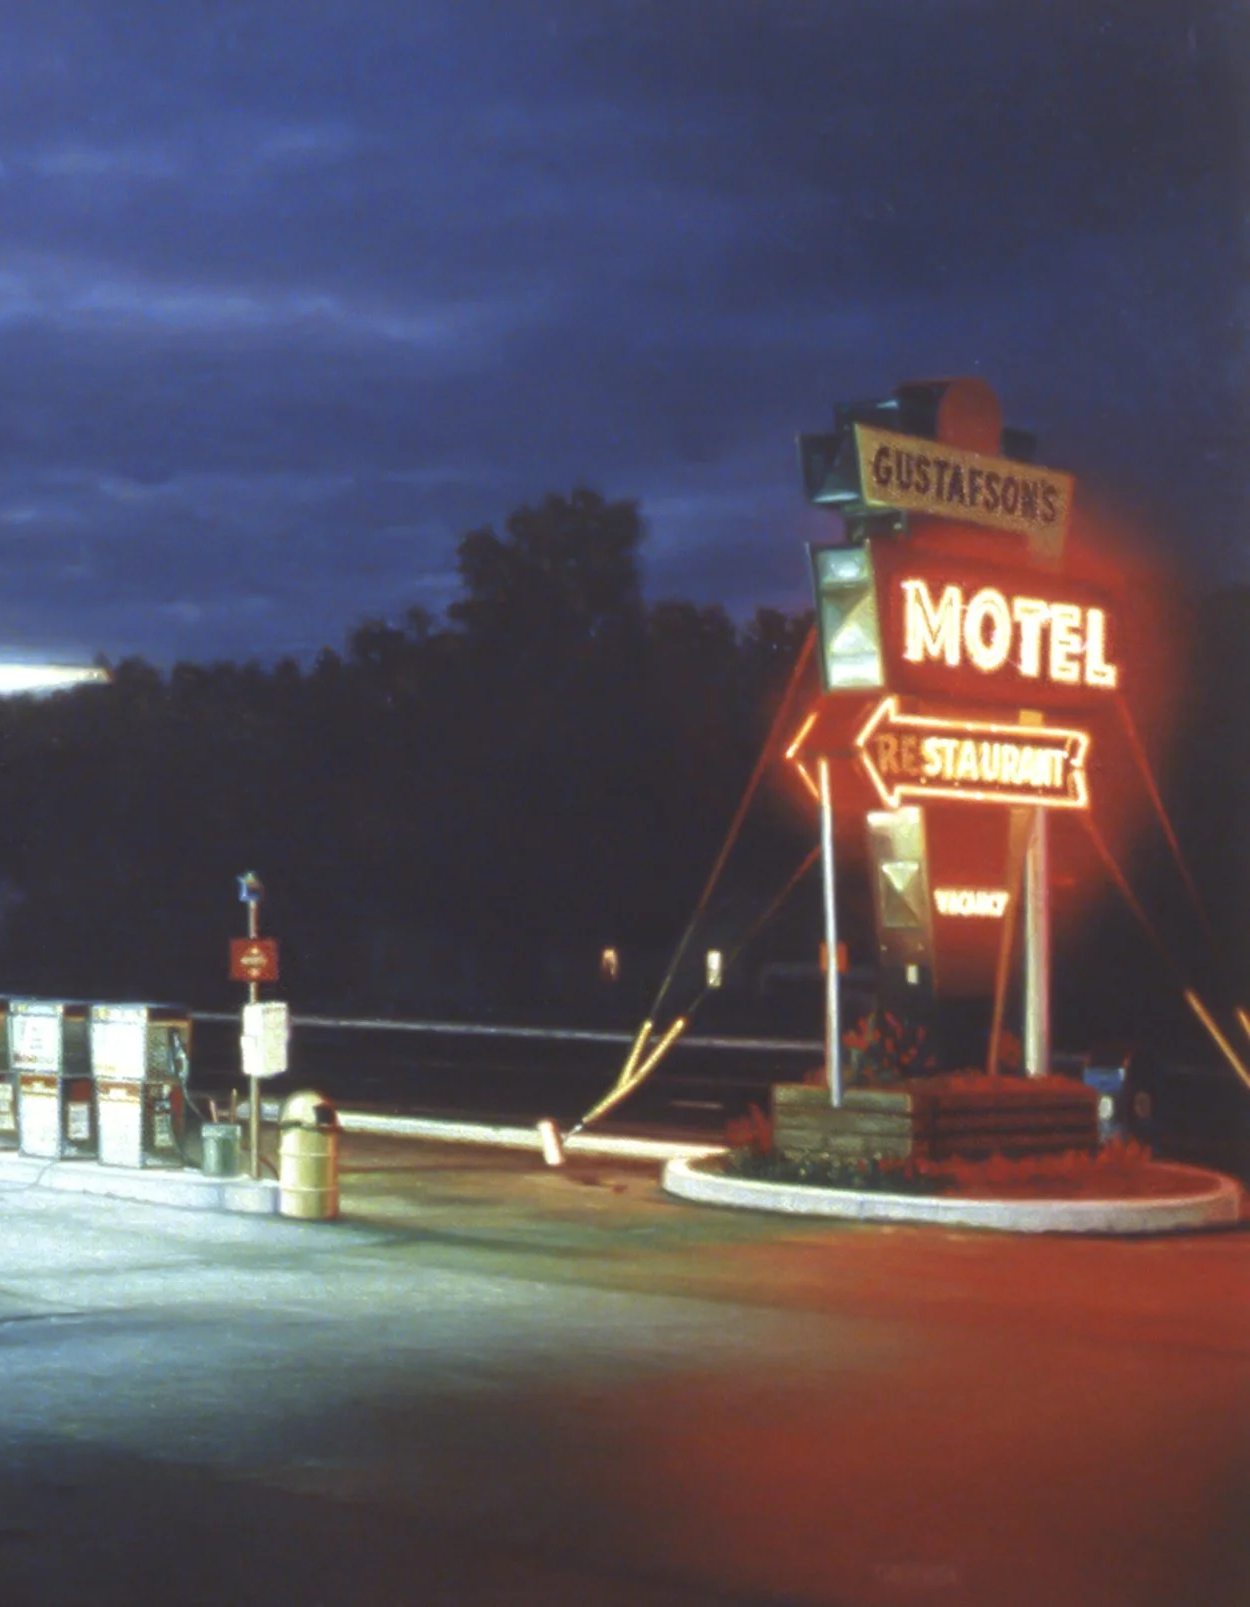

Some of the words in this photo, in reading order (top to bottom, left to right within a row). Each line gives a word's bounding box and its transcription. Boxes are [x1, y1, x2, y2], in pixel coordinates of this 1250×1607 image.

[873, 446, 1058, 523] GUSTAFSON'S
[902, 579, 1117, 688] MOTEL
[877, 733, 1067, 788] RESTAURANT
